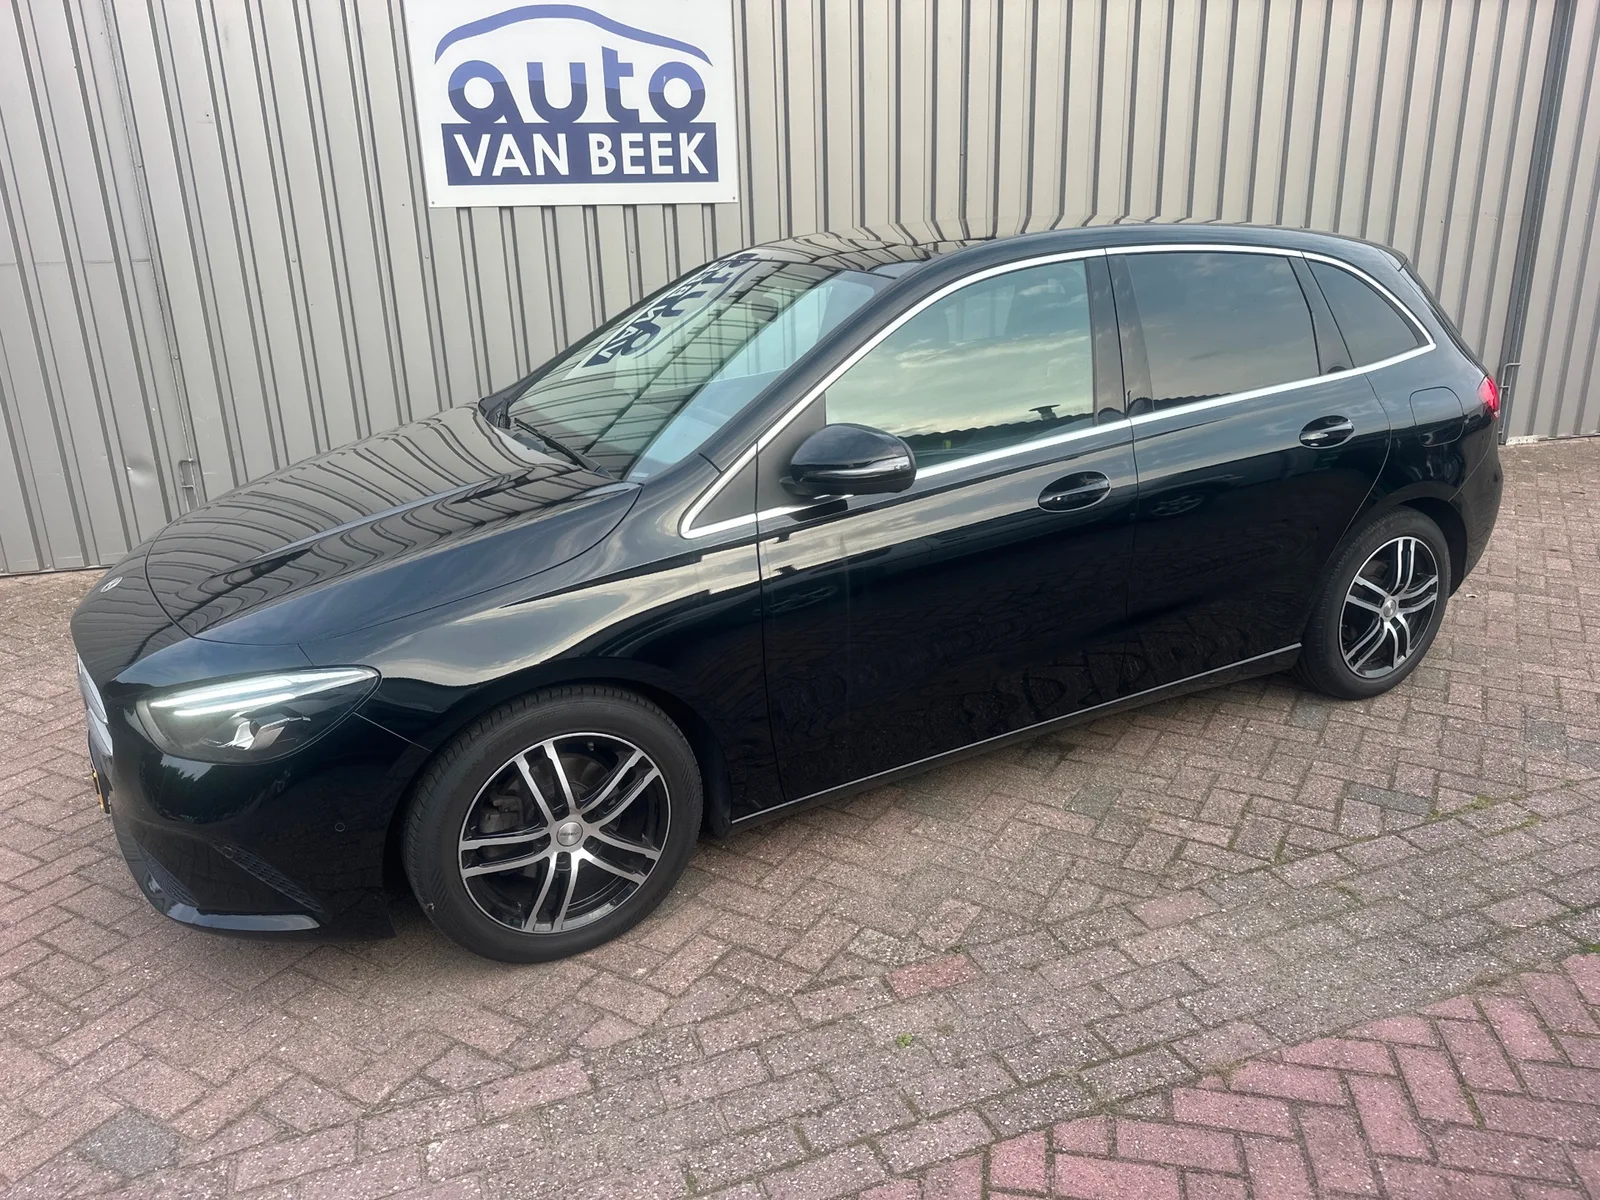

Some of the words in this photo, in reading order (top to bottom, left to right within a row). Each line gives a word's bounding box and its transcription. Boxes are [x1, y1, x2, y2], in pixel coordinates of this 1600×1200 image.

[447, 46, 706, 123] auto
[453, 133, 570, 177] VAN
[588, 132, 709, 176] BEEK
